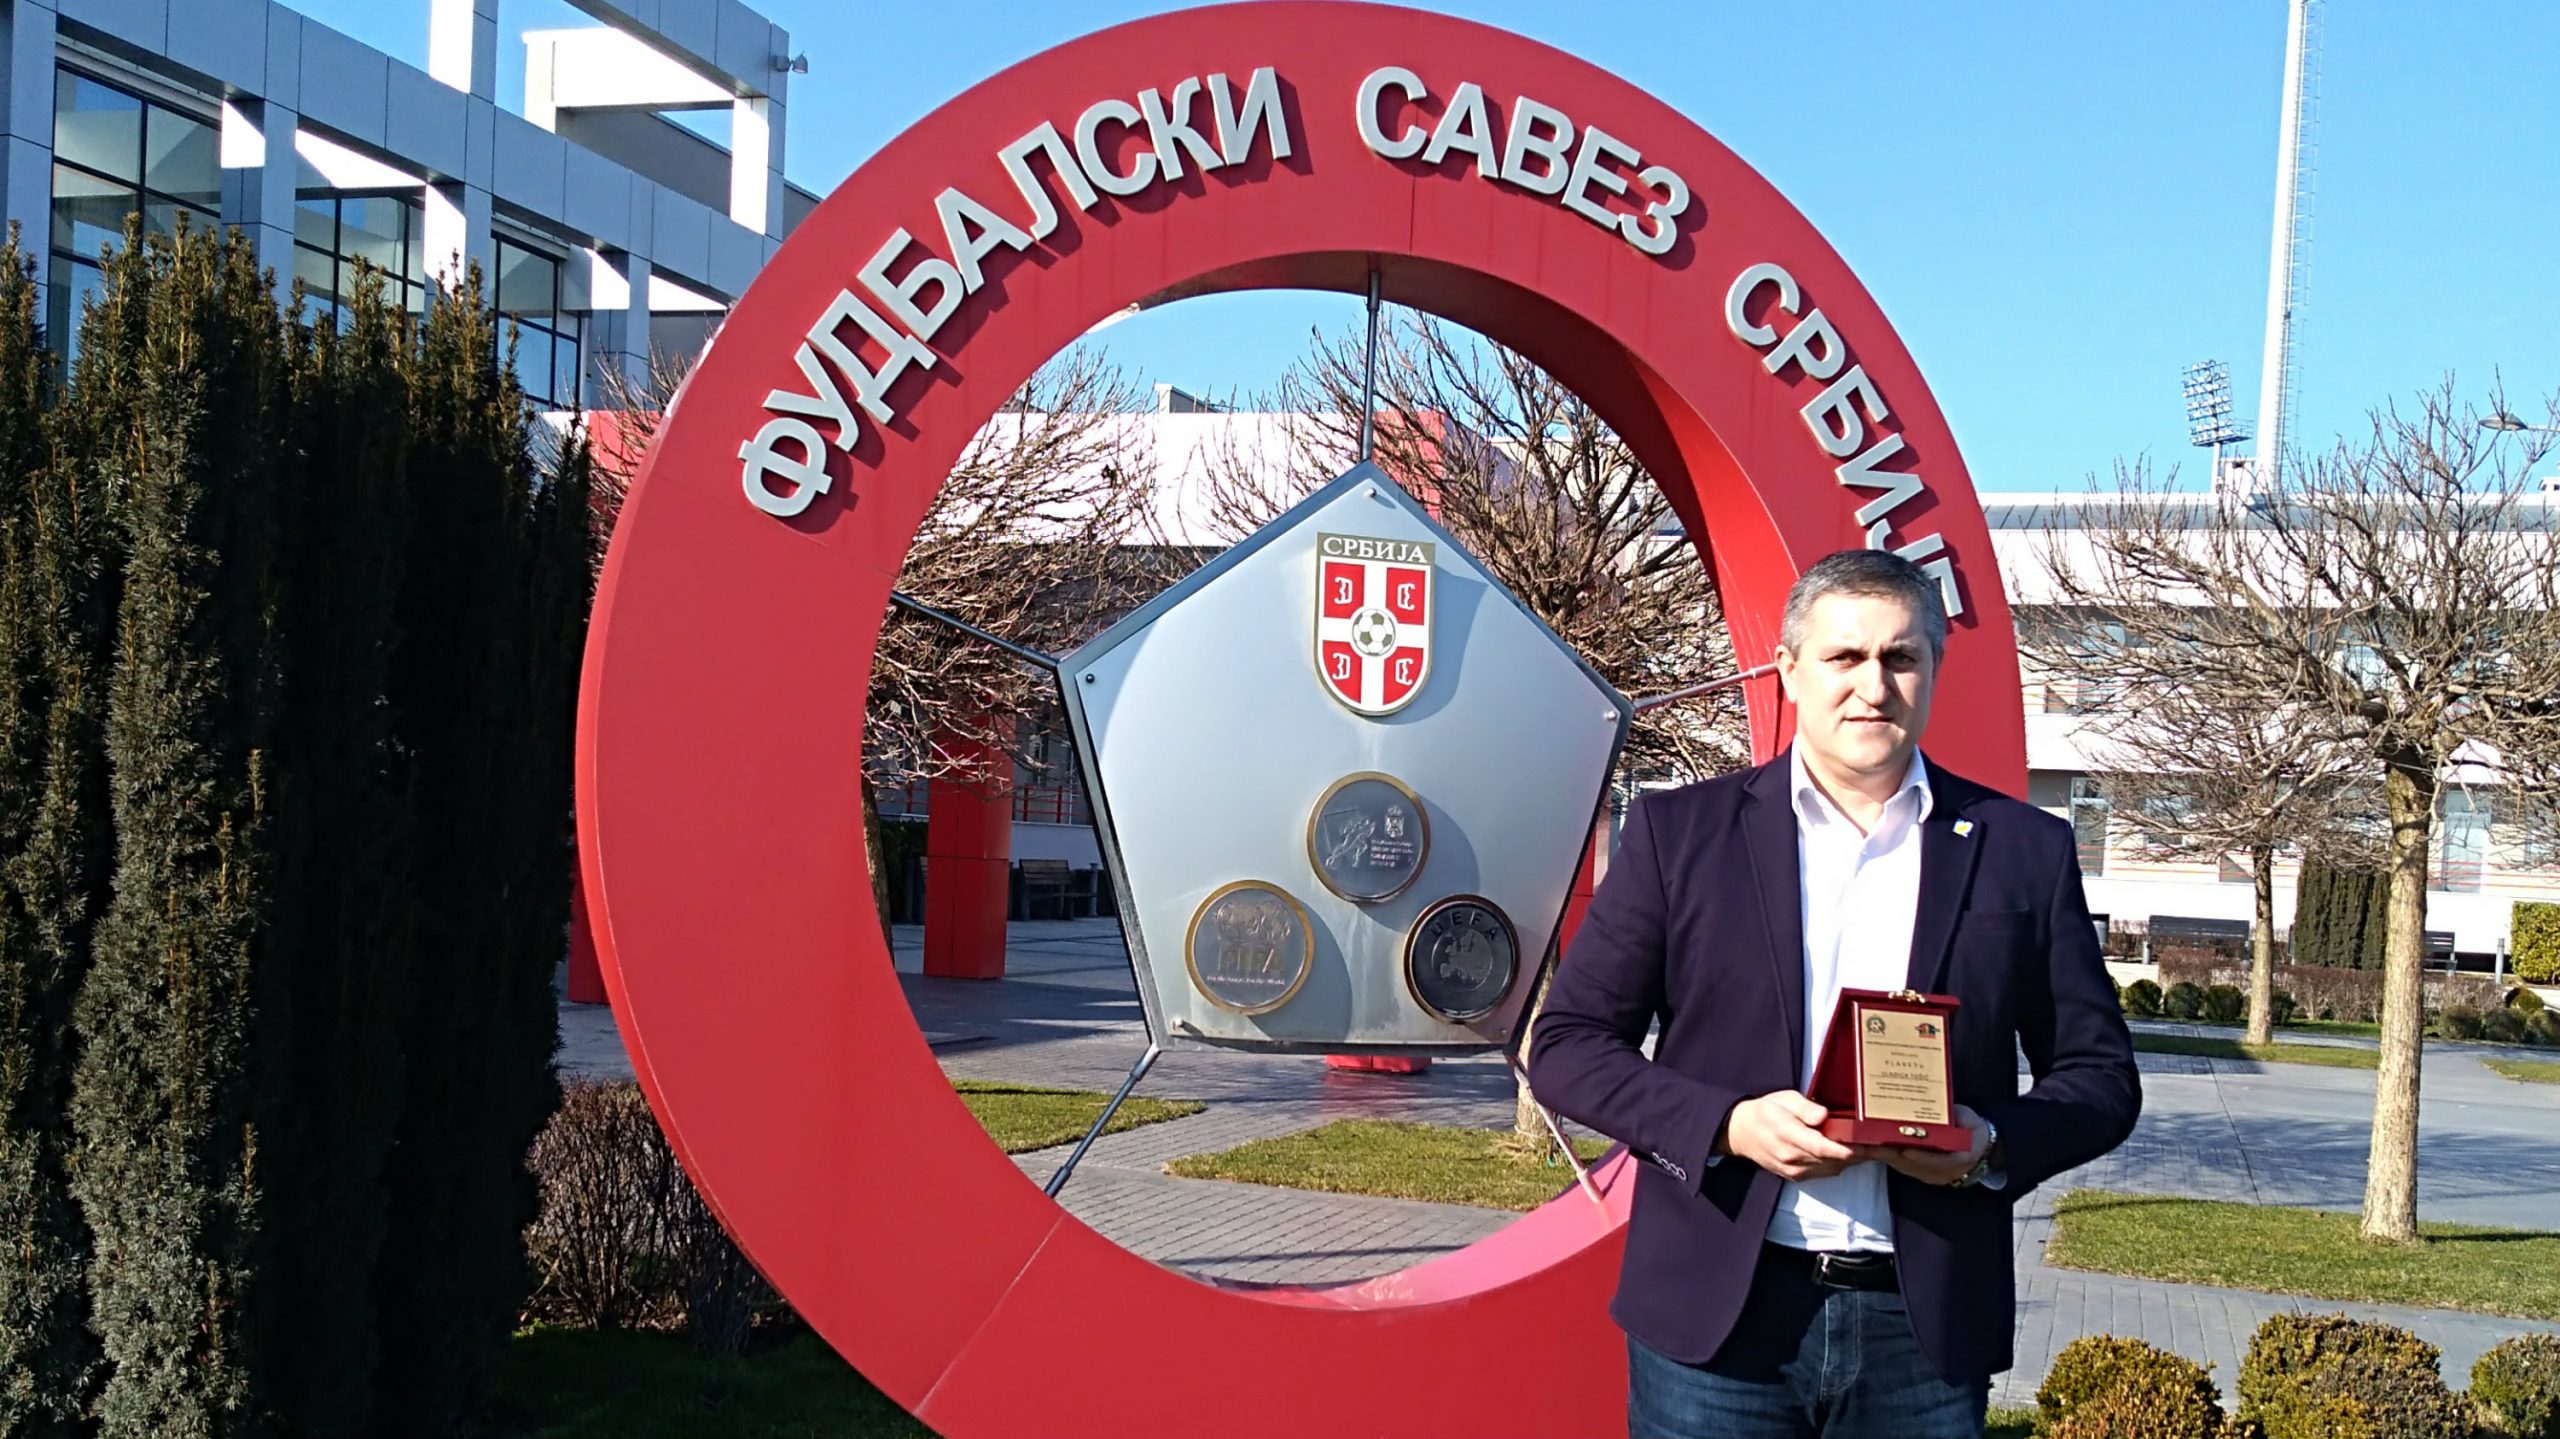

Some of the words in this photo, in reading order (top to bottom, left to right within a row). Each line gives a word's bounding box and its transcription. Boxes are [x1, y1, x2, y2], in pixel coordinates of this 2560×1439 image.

[737, 66, 1292, 518] ФУДБАЛСКИ
[1355, 66, 1690, 256] САВЕЗ
[1323, 536, 1427, 563] СРБИЈА
[1430, 910, 1500, 941] UEFA
[1217, 943, 1287, 975] FIFA
